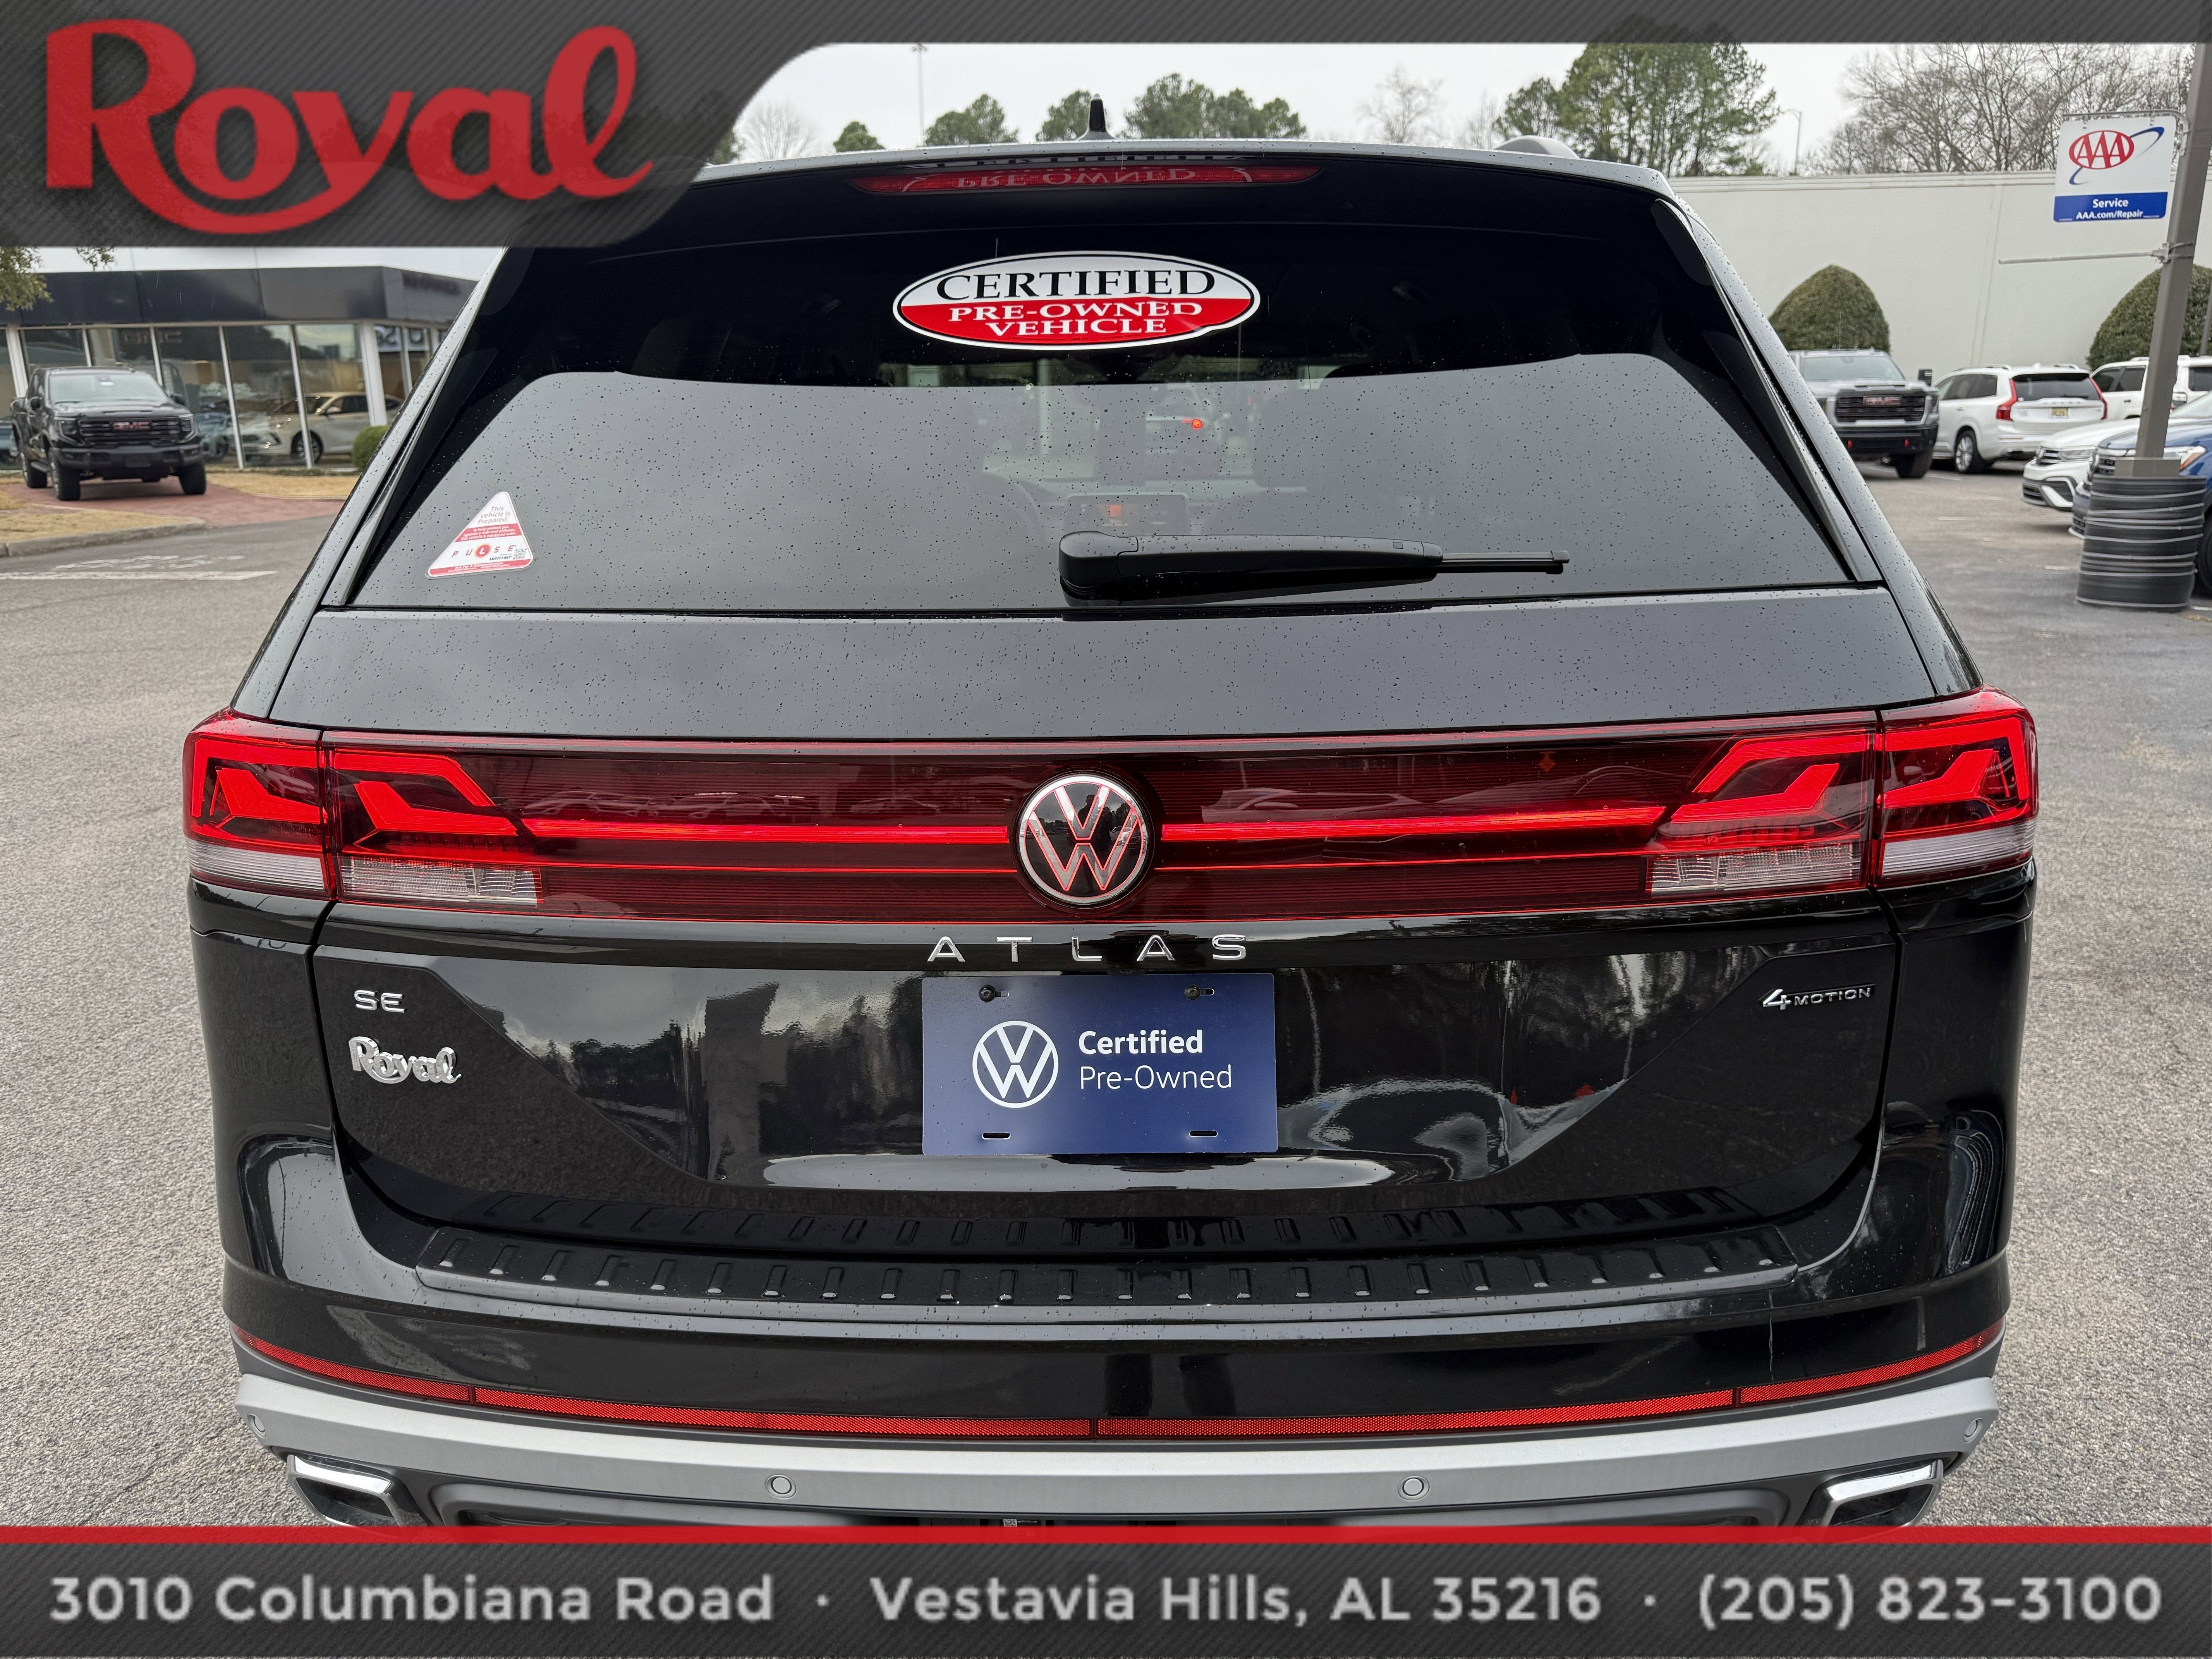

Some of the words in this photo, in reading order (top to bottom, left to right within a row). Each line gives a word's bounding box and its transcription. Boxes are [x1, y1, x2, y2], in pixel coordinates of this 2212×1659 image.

[2075, 131, 2128, 169] AAA
[2076, 210, 2143, 220] AAA.com/Repair
[2092, 198, 2129, 208] Service
[936, 270, 1216, 300] CERTIFIED
[948, 301, 1202, 322] PRE-OWNED
[985, 318, 1167, 336] VEHICLE
[927, 934, 1247, 962] ATLAS
[354, 990, 405, 1013] SE
[1763, 988, 1870, 1010] 4MOTION
[1079, 1029, 1203, 1055] Certified
[349, 1036, 462, 1084] Royal
[1080, 1063, 1232, 1090] Pre-Owned
